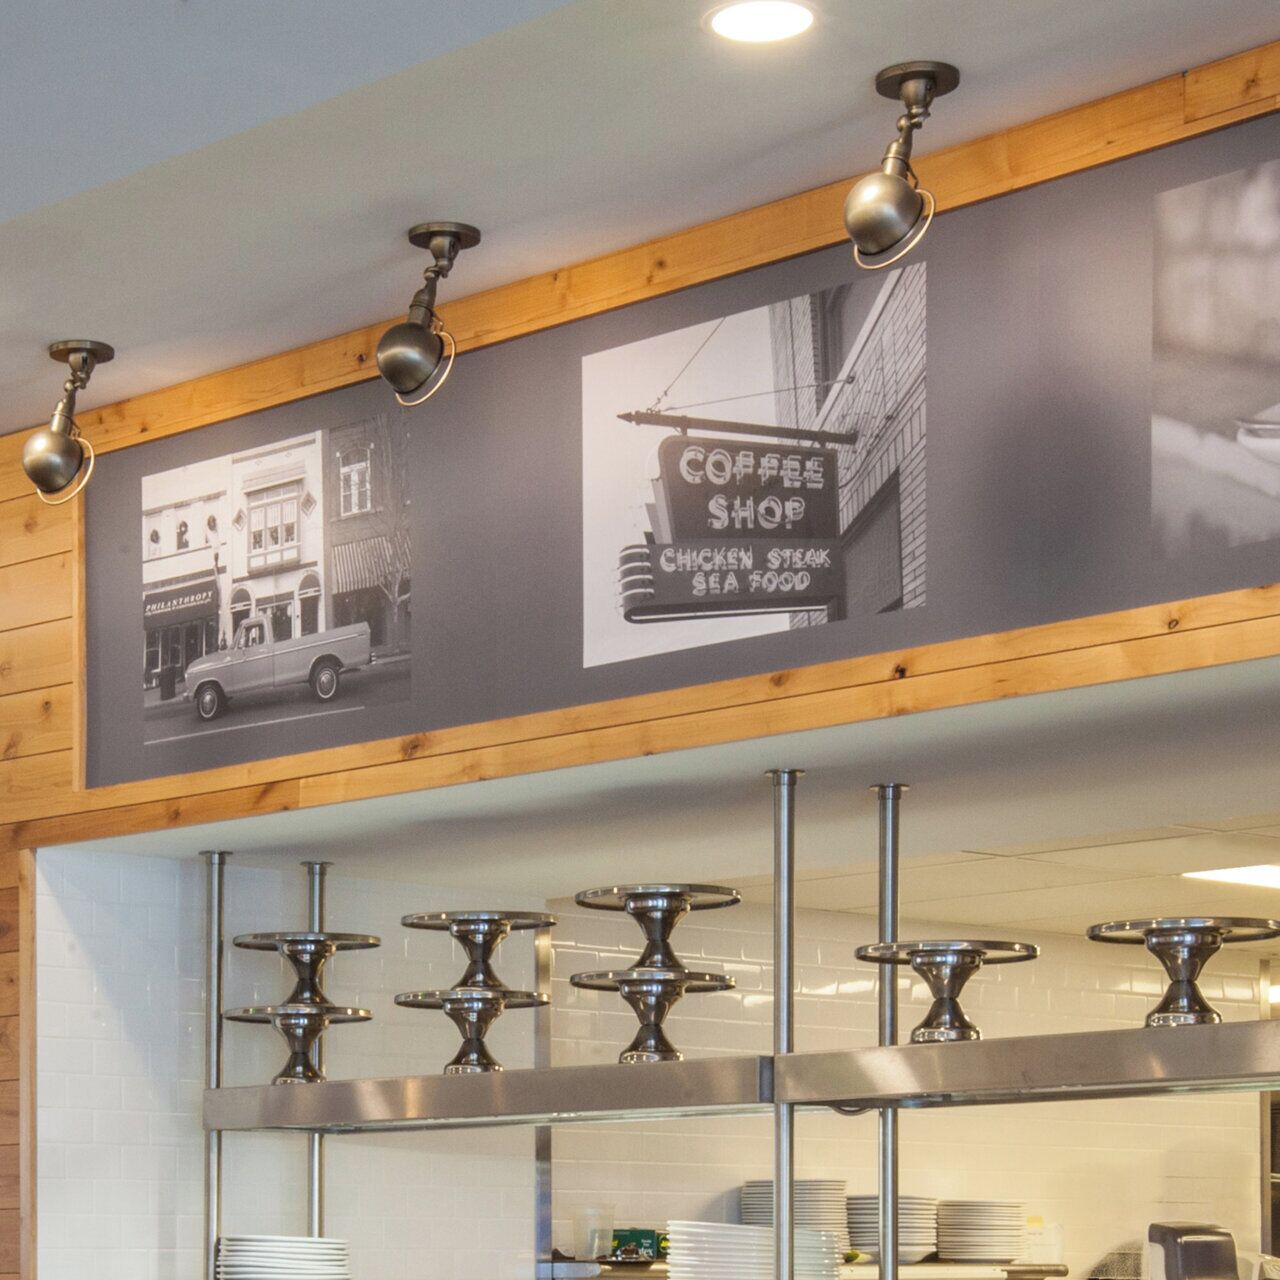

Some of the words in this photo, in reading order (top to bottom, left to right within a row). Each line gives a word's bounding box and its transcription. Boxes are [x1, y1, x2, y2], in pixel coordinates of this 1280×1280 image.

[679, 445, 824, 489] COFFEE
[707, 493, 805, 529] SHOP
[659, 545, 753, 572] CHICKEN
[767, 548, 831, 569] STEAK
[692, 571, 739, 596] SEA
[749, 570, 811, 592] FOOD
[145, 590, 213, 612] PHILANTHROPY
